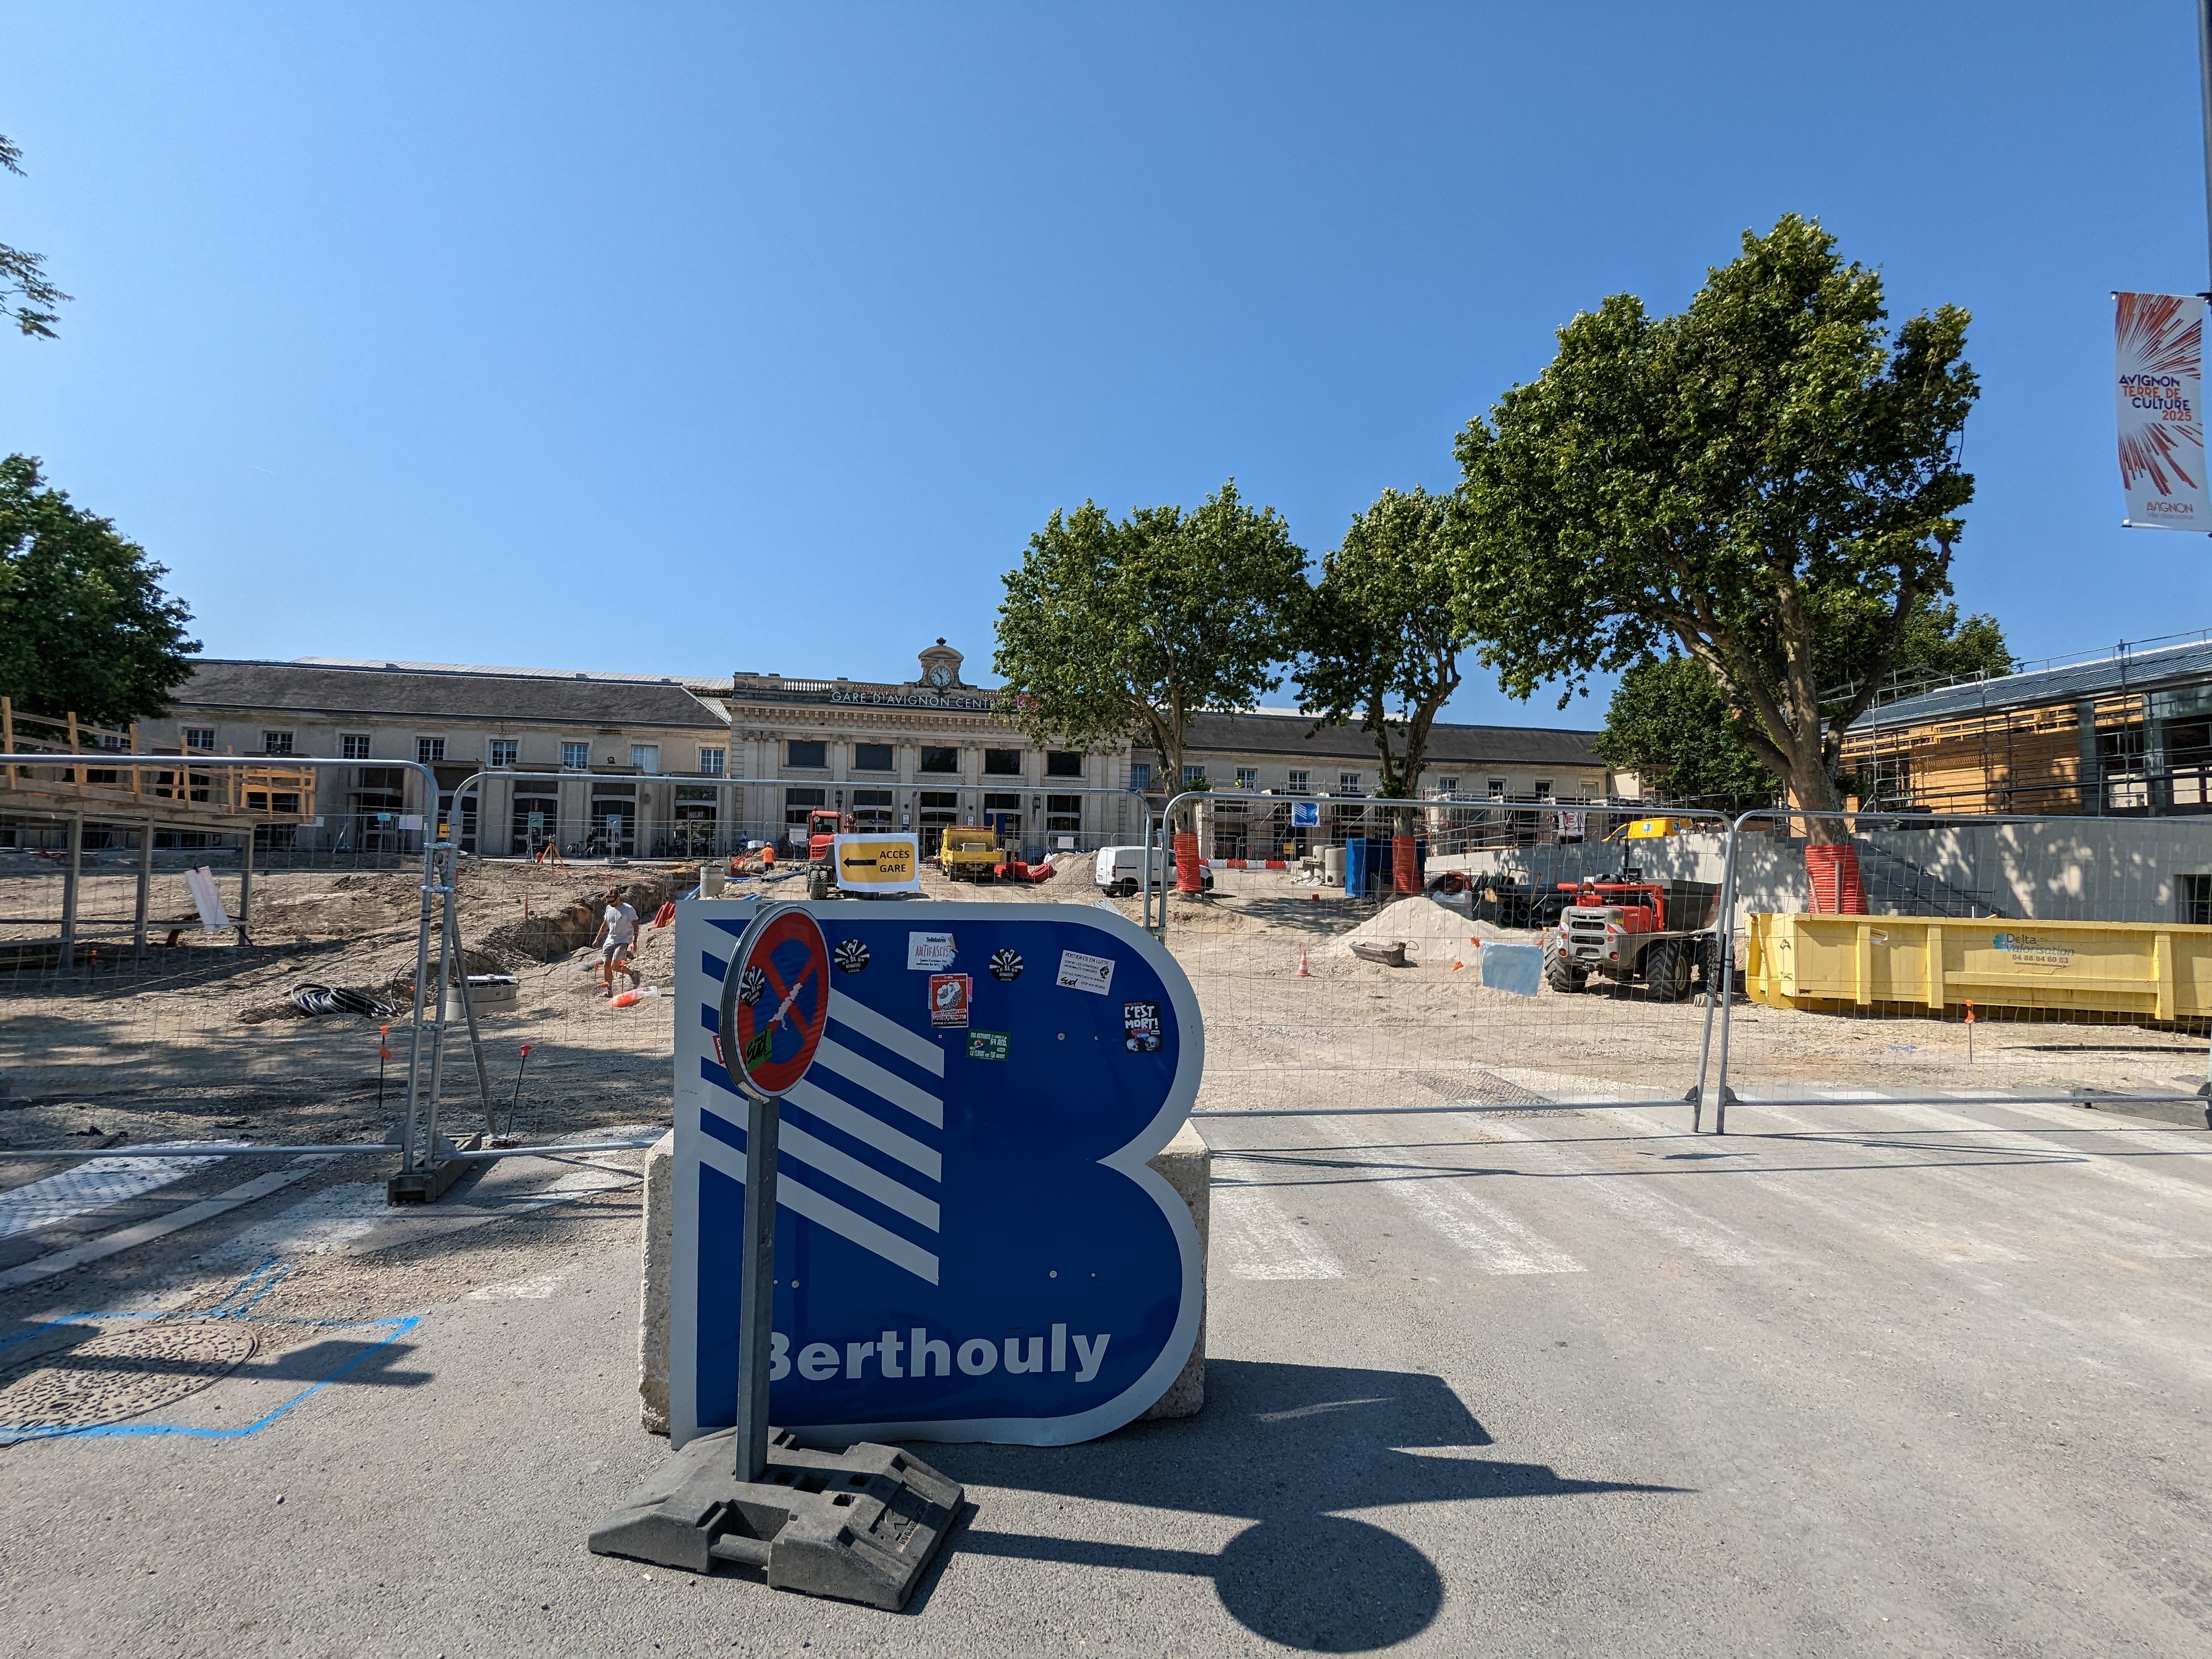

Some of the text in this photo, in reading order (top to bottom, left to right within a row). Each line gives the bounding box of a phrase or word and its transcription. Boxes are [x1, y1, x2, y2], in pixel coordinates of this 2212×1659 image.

[2119, 374, 2180, 387] AVIGNON
[2122, 385, 2182, 399] TERRE DE
[2132, 397, 2191, 411] CULTURE
[2162, 410, 2192, 421] 2025
[2147, 501, 2193, 513] AVIGNON
[832, 691, 866, 703] GARE
[956, 699, 995, 708] CENTR
[879, 849, 910, 859] ACCÈS
[879, 864, 906, 873] GARE
[2007, 933, 2037, 944] Delta
[2006, 944, 2074, 956] Valorisation
[1125, 1005, 1155, 1018] C'EST
[1125, 1018, 1158, 1030] MORT!
[770, 1323, 1111, 1383] Berthouly
